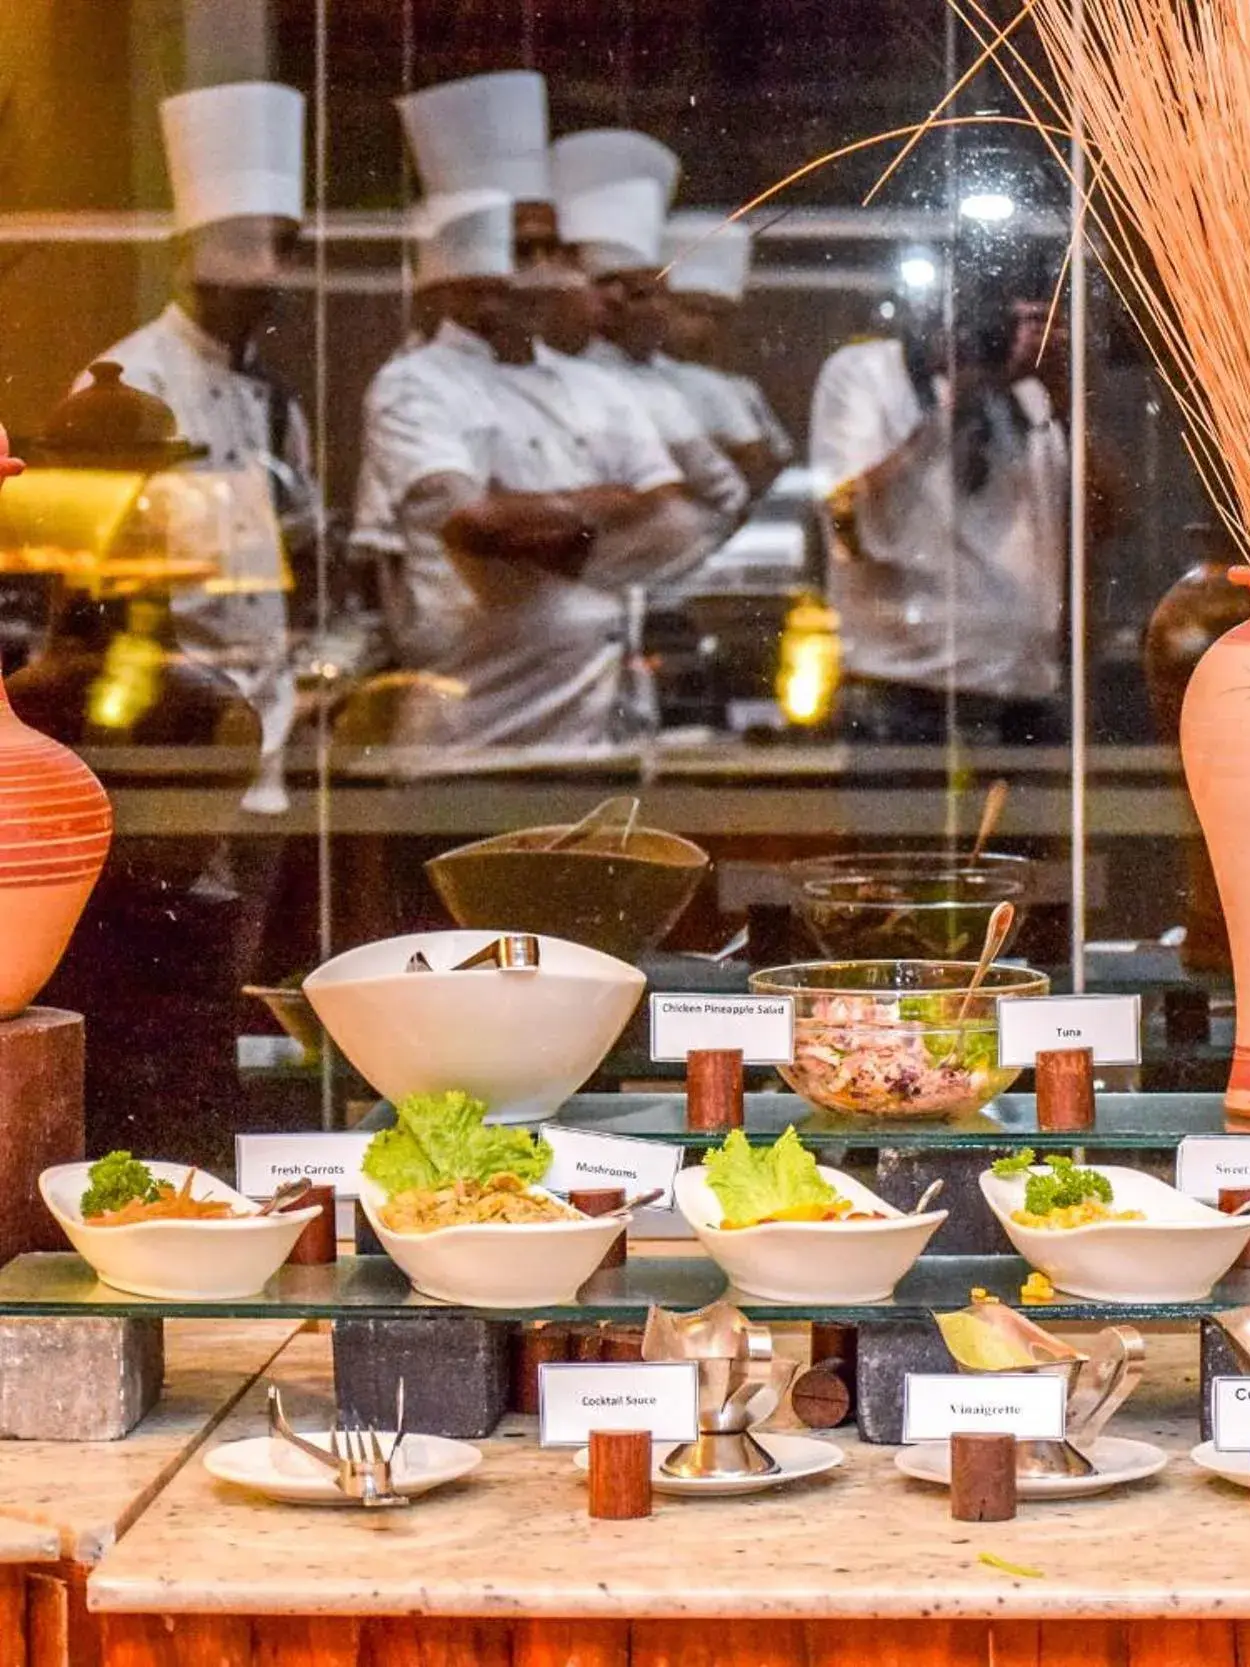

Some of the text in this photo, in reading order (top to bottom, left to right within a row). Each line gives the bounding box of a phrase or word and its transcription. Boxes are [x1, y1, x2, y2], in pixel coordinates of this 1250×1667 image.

[663, 1003, 785, 1015] Chicken Pineapple Salad
[1056, 1027, 1082, 1037] Tuna
[271, 1165, 345, 1174] Fresh Carrots
[575, 1161, 637, 1179] Mushrooms
[1216, 1163, 1249, 1175] Sweet
[581, 1396, 656, 1406] Cocktail Sauce
[950, 1404, 1021, 1416] Vinaigrette
